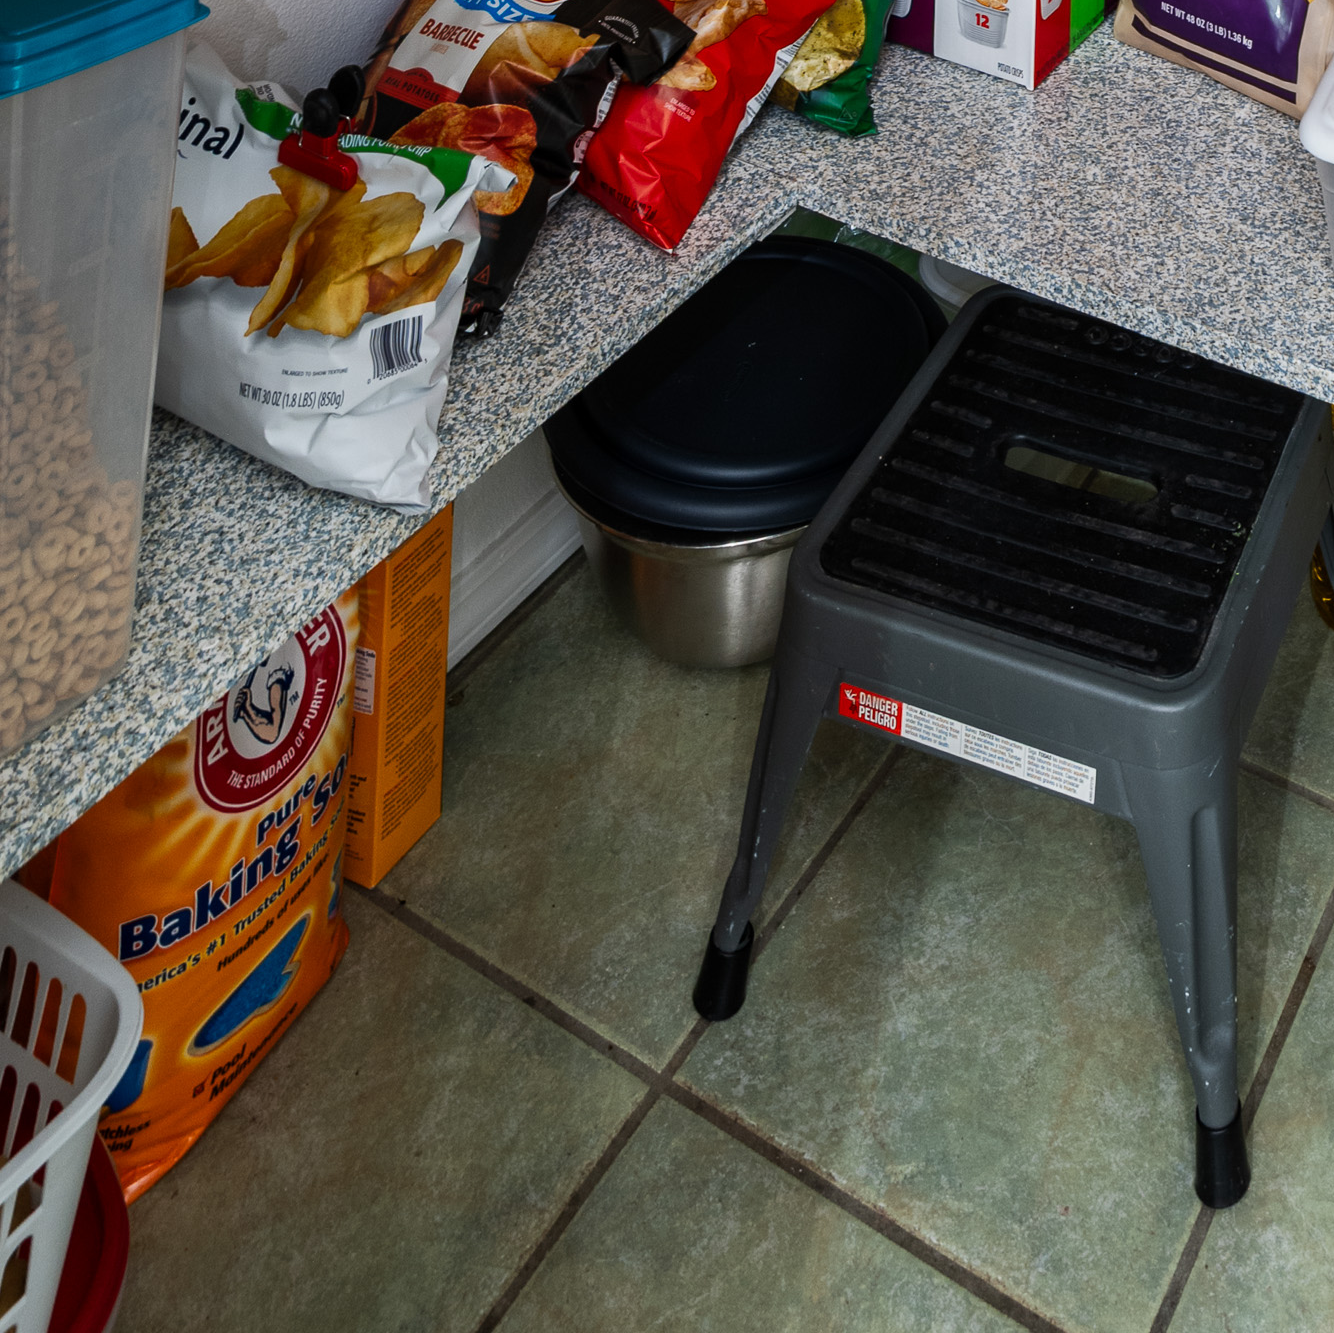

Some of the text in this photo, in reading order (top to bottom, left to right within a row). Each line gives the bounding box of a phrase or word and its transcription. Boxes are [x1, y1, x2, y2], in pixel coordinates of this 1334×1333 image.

[418, 15, 486, 51] BARBECUE
[974, 12, 991, 30] 12
[226, 769, 244, 787] THE
[243, 746, 296, 790] STANDARD
[295, 728, 307, 749] OF
[303, 676, 328, 731] PURITY
[858, 691, 899, 716] DANGER
[858, 706, 898, 731] PELIGRO
[256, 772, 318, 848] Pure
[118, 809, 304, 964] Baking
[206, 825, 330, 957] #1 Trusted Baking
[207, 1002, 299, 1103] Maintenance
[210, 1043, 249, 1085] Pool
